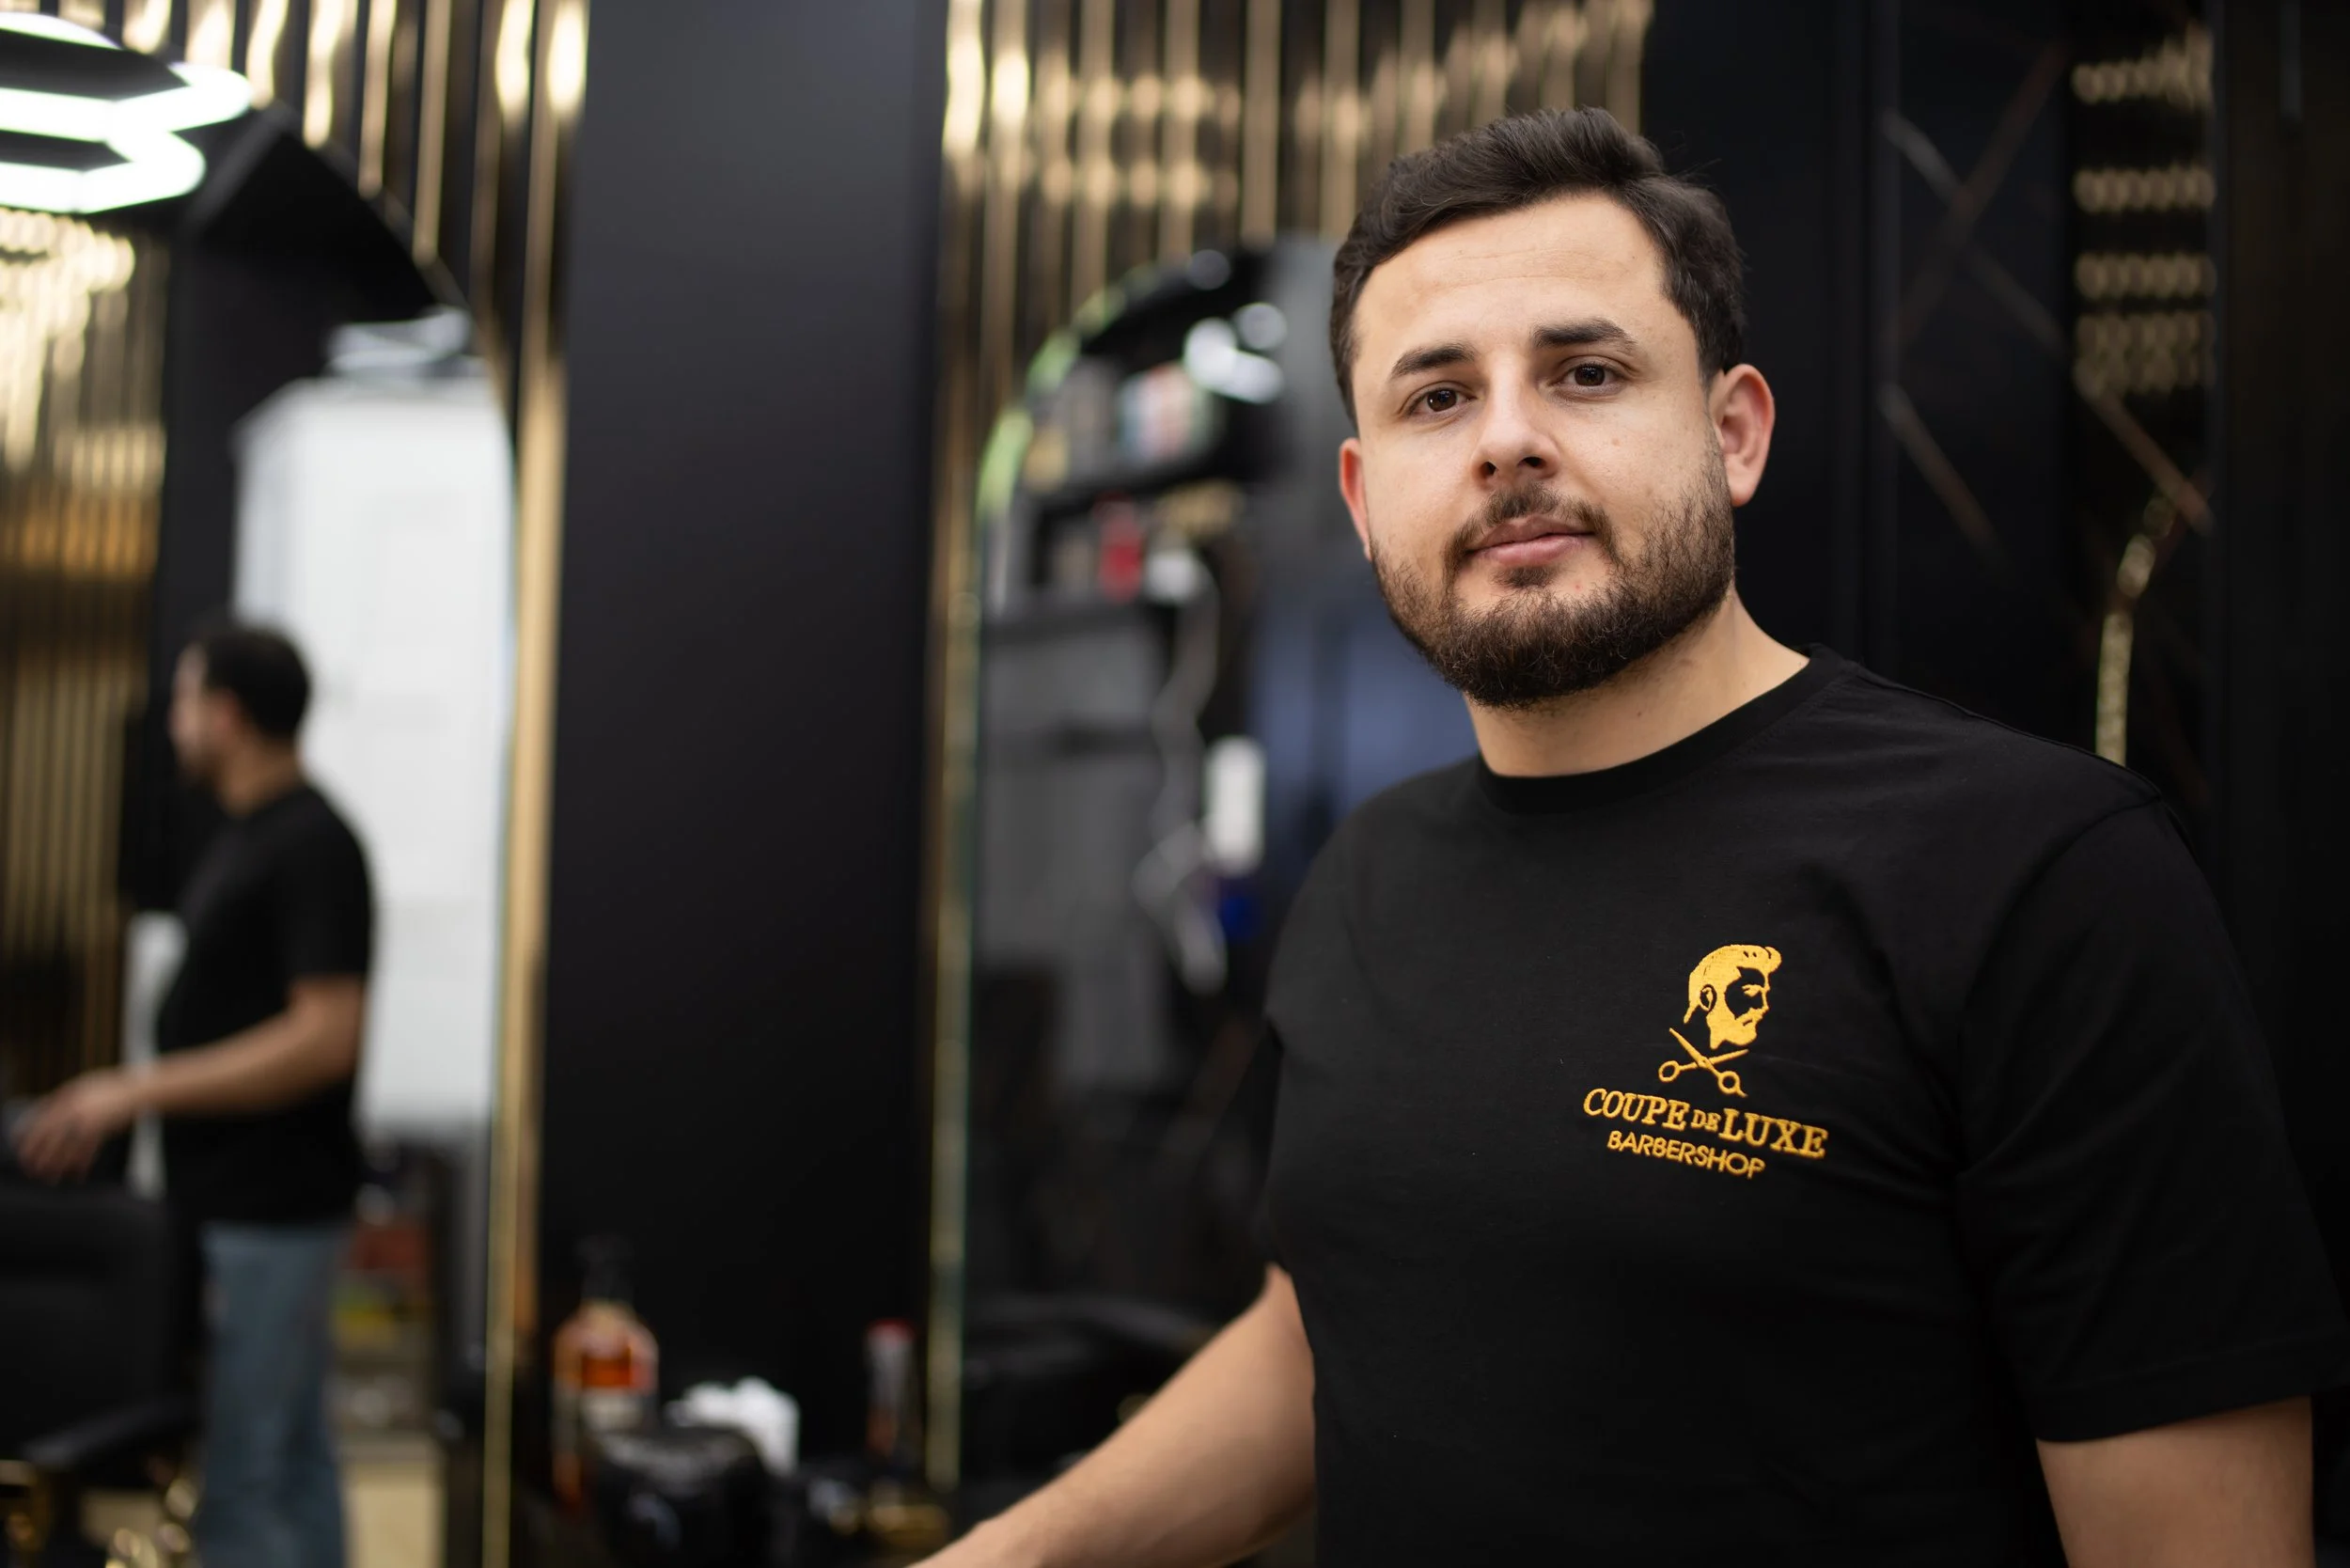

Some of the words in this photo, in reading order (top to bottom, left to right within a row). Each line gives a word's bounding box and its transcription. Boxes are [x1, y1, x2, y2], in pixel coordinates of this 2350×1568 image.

[1583, 1088, 1691, 1132] COUPE
[1690, 1108, 1722, 1133] DE
[1717, 1107, 1829, 1159] LUXE
[1606, 1130, 1765, 1179] BARBERSHOP
